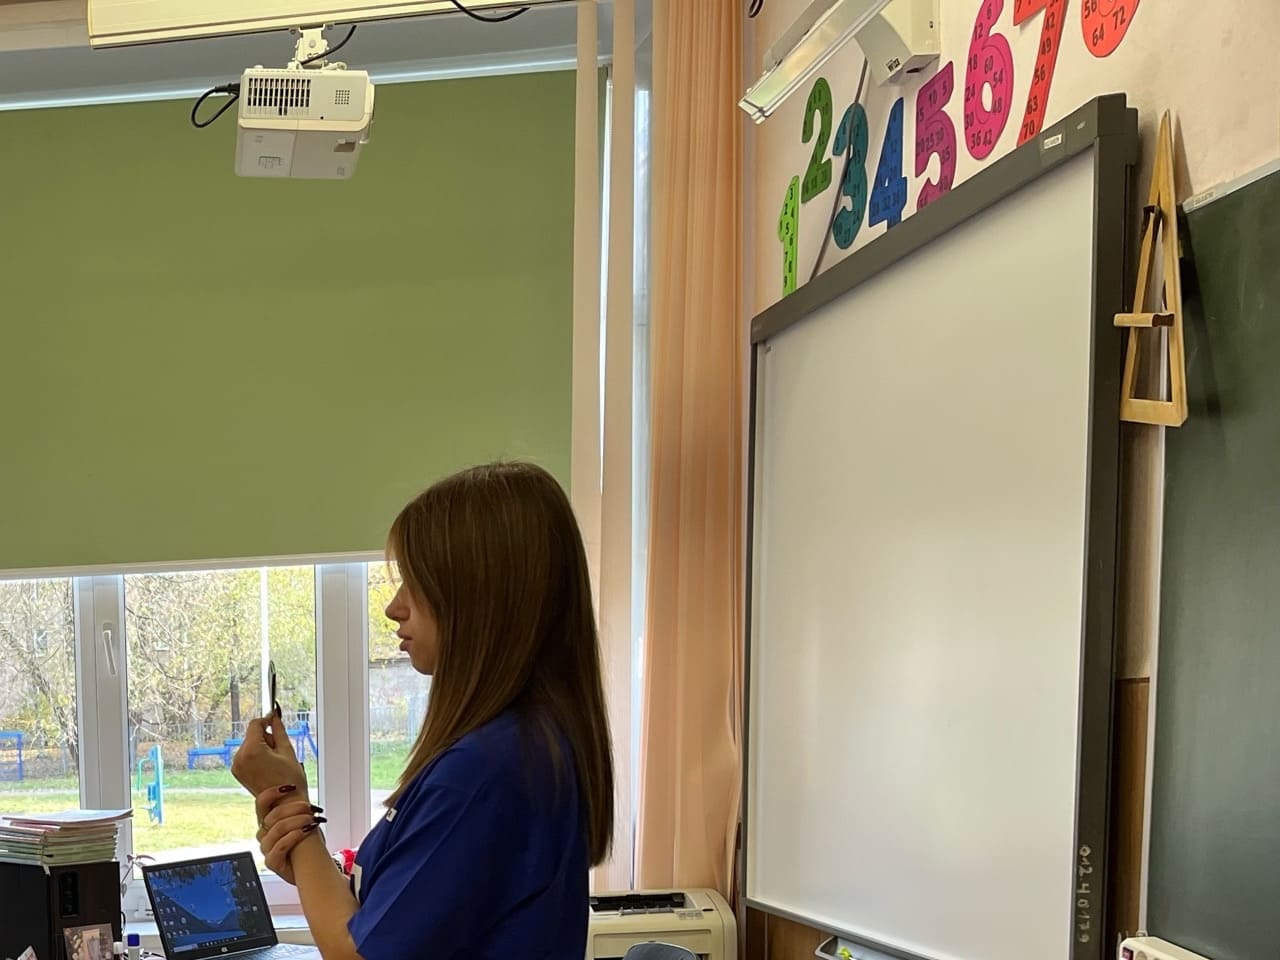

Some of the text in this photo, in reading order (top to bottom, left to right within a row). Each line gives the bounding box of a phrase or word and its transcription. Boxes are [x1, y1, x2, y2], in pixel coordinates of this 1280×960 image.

[1045, 11, 1056, 32] 42
[1112, 5, 1126, 31] 72
[1092, 23, 1105, 47] 64
[1041, 37, 1052, 56] 49
[984, 55, 994, 75] 60
[1034, 64, 1046, 86] 56
[942, 80, 948, 96] 5
[993, 68, 1004, 89] 54
[1026, 95, 1039, 115] 63
[801, 77, 832, 204] 2
[832, 102, 868, 249] 3
[869, 96, 907, 229] 4
[915, 61, 957, 212] 5
[964, 0, 1014, 160] 6
[1023, 119, 1035, 140] 70
[971, 130, 982, 150] 36
[983, 128, 993, 147] 42
